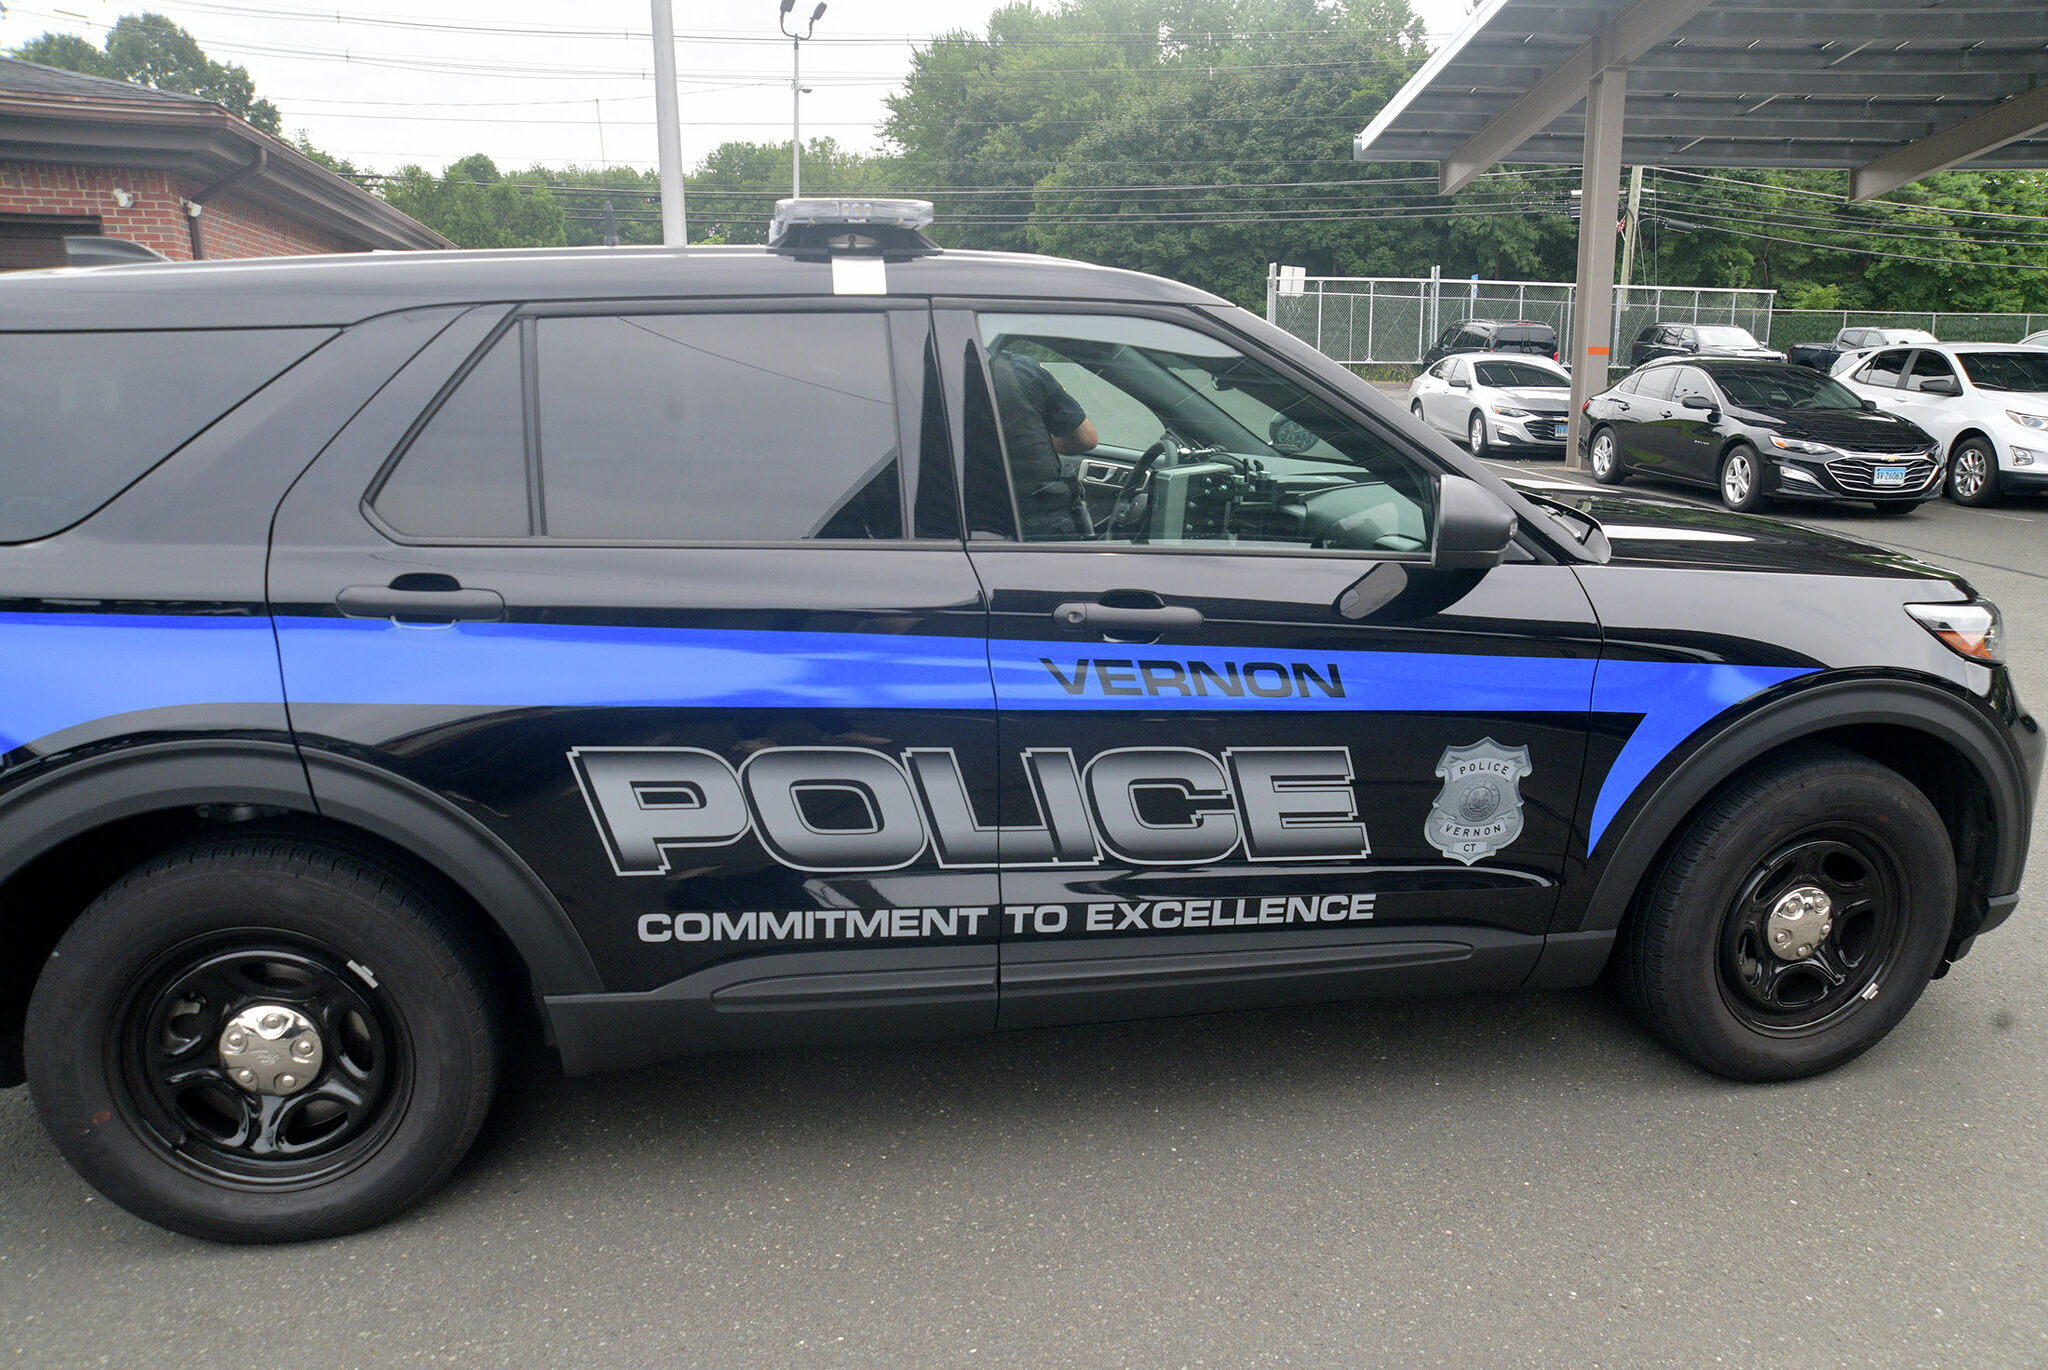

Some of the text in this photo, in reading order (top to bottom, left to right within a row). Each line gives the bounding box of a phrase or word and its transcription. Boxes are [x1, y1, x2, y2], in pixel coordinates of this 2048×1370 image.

[1039, 658, 1346, 698] VERNON
[1460, 762, 1509, 775] POLICE
[566, 746, 1372, 876] POLICE
[1445, 824, 1501, 837] VERNON
[1463, 843, 1476, 852] CT
[637, 893, 1377, 943] COMMITMENT TO EXCELLENCE
